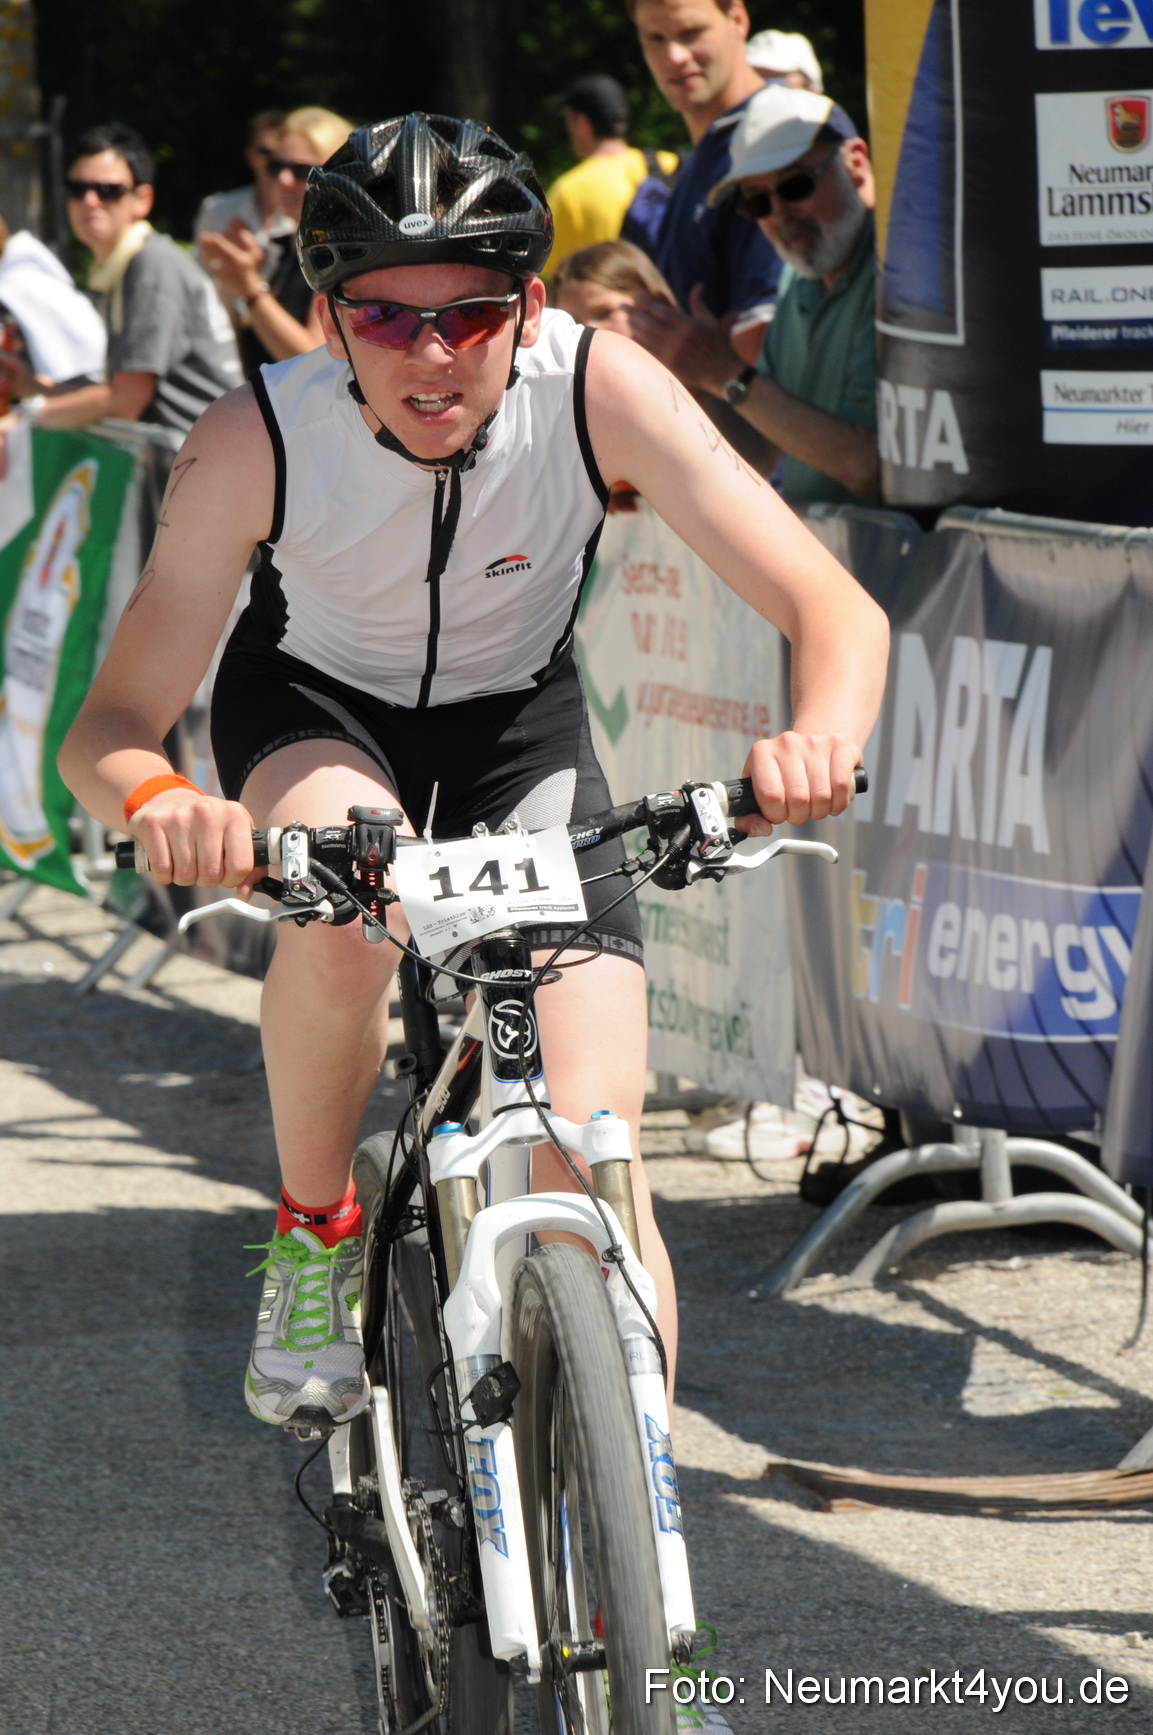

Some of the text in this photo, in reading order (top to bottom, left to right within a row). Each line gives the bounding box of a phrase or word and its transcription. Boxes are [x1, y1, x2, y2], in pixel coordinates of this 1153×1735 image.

[1047, 185, 1153, 217] Lamms
[403, 218, 429, 230] uvex
[1051, 286, 1153, 304] RAIL.ON
[1115, 418, 1150, 435] Hier
[485, 562, 532, 579] skinfit
[569, 826, 604, 843] CHEY
[428, 857, 550, 902] 141
[480, 968, 532, 981] GHOST
[643, 1412, 685, 1540] FOX
[458, 1436, 509, 1559] FOX
